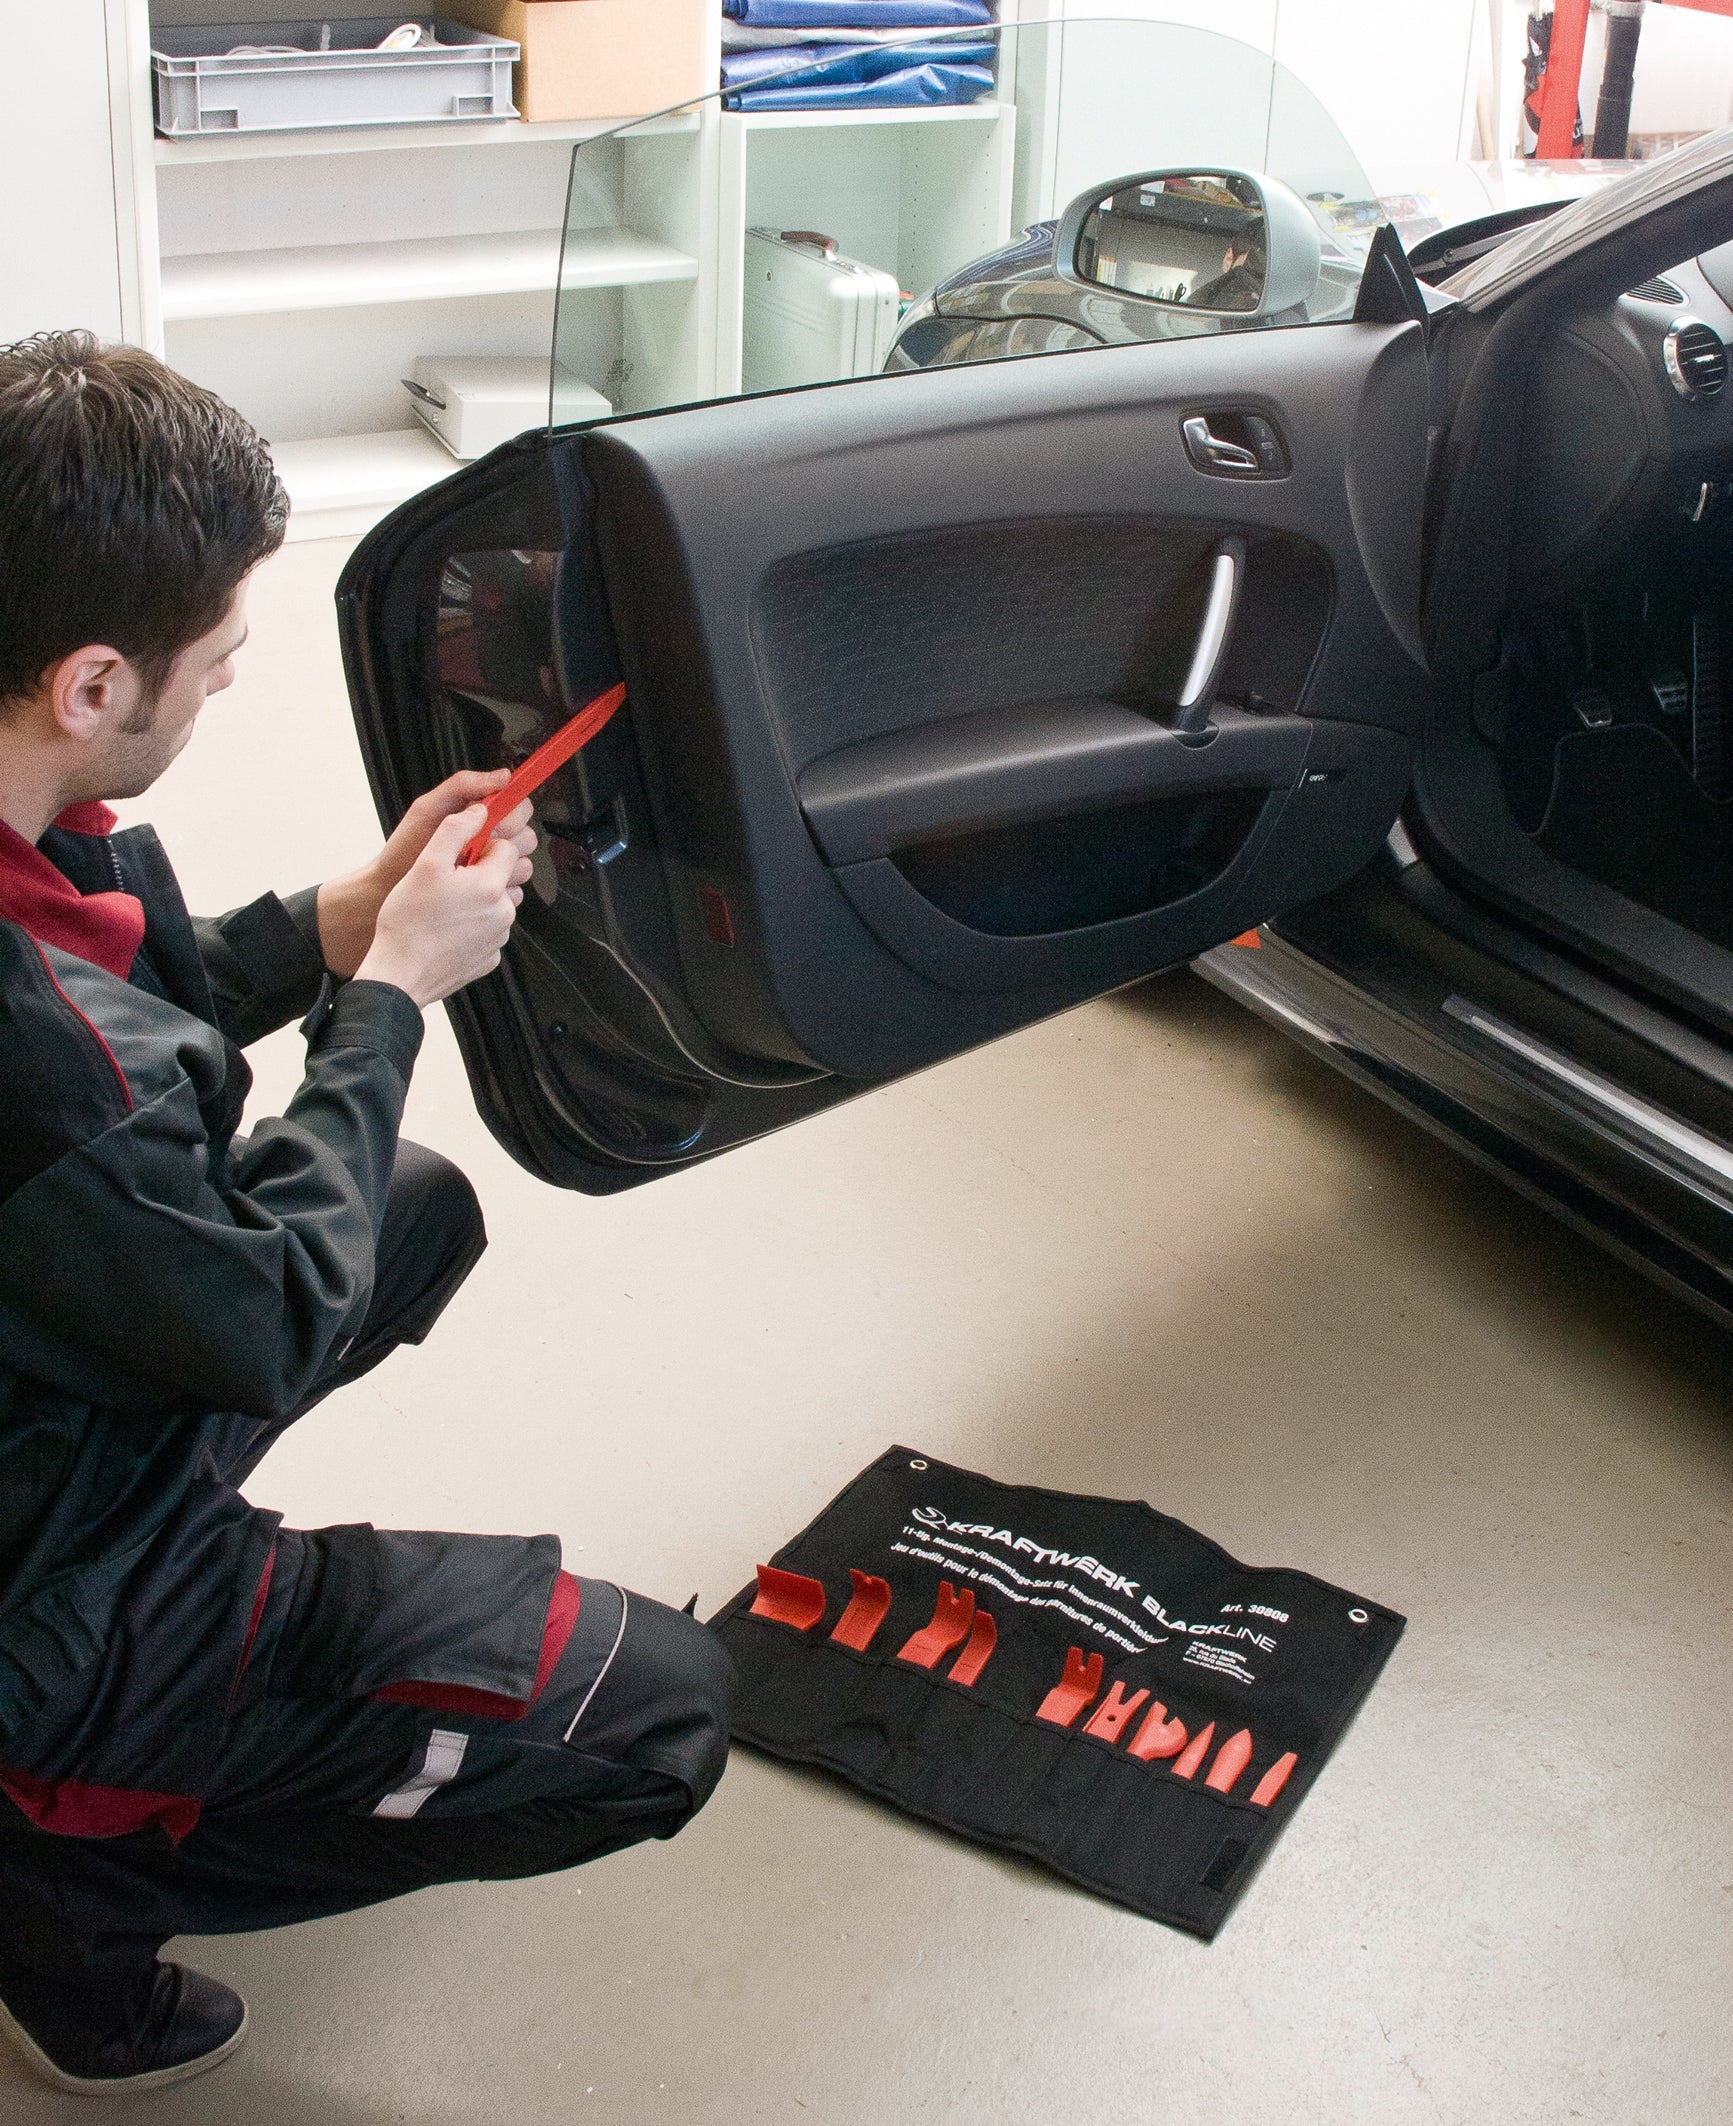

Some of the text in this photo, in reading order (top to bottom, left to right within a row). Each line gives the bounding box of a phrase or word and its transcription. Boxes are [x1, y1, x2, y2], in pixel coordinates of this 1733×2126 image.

[891, 1541, 908, 1552] Jeu
[942, 1559, 968, 1576] pour
[967, 1567, 980, 1580] le
[1092, 1622, 1107, 1633] de
[947, 1521, 1277, 1653] KRAFTWERK BLACKLINE
[1053, 1580, 1069, 1590] für
[1220, 1604, 1244, 1613] Art.
